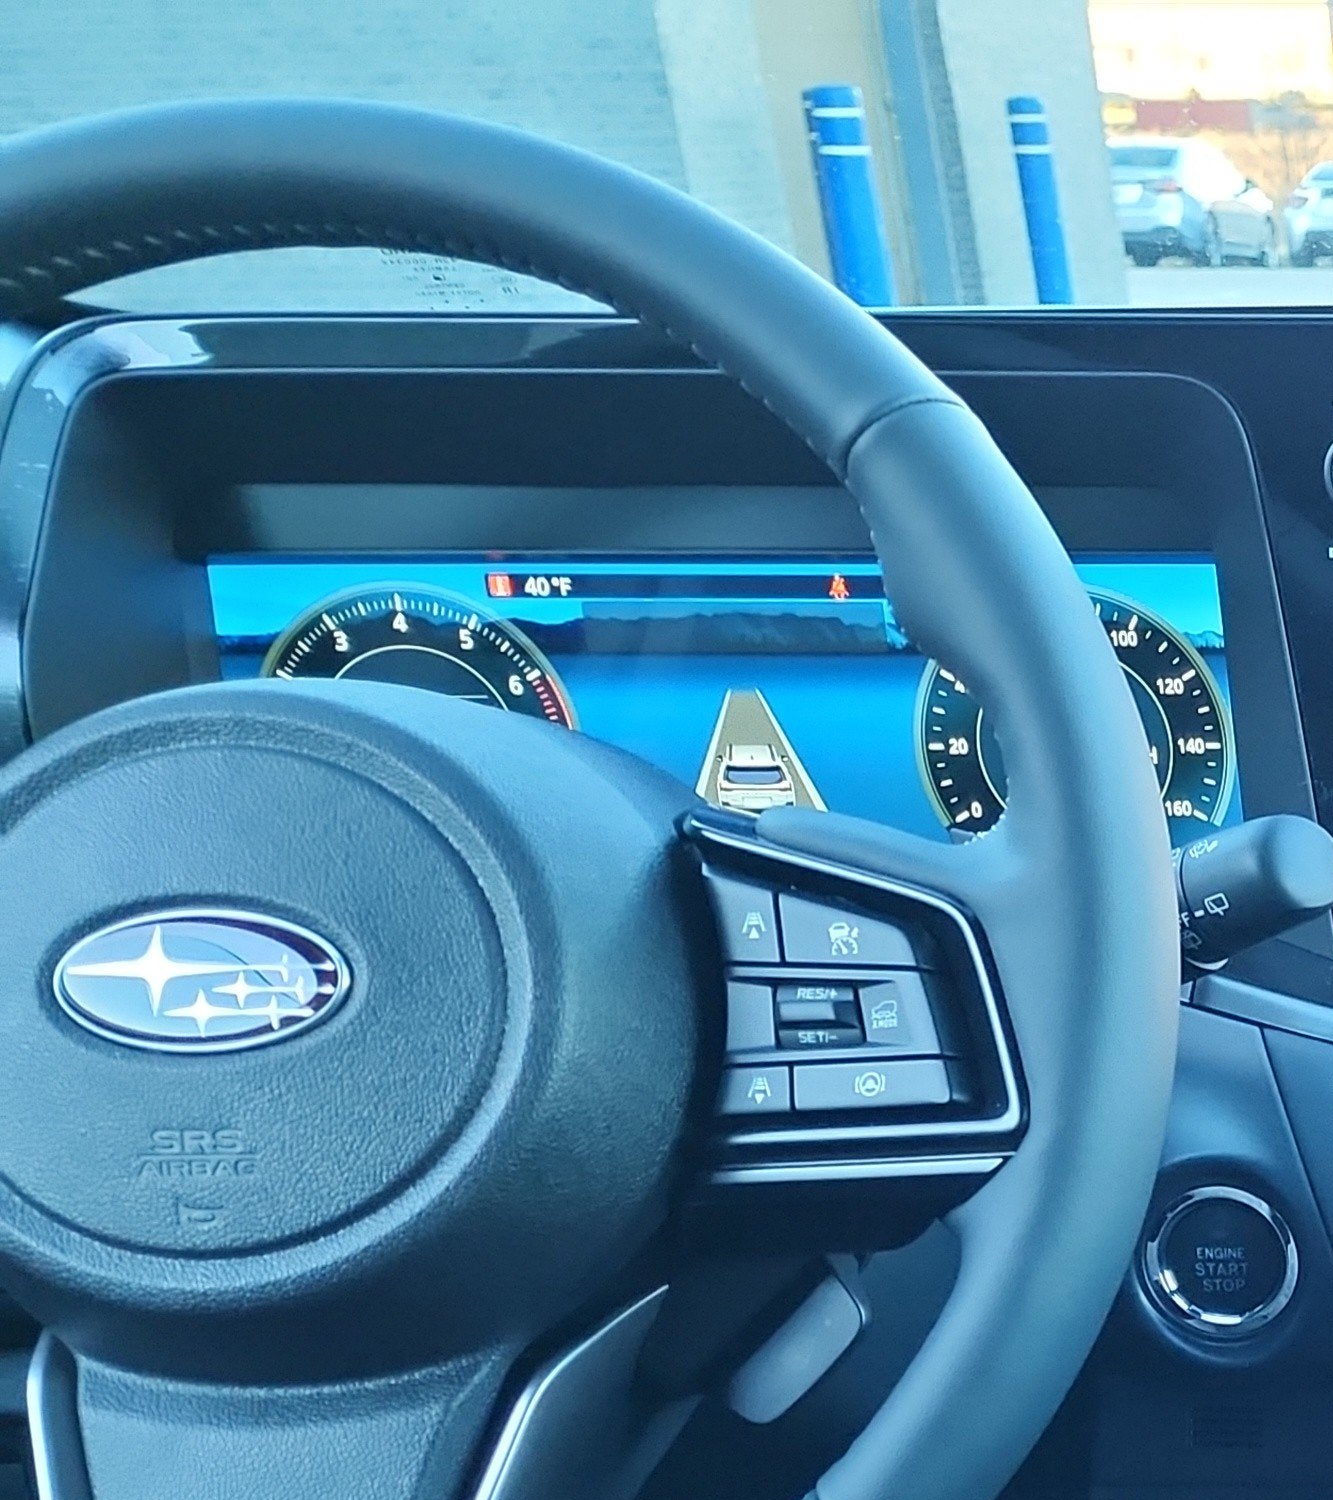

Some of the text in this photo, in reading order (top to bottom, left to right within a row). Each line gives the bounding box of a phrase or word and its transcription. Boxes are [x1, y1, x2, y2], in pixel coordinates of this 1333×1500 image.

[392, 613, 409, 633] 4
[334, 631, 349, 652] 3
[458, 629, 474, 650] 5
[1110, 630, 1138, 647] 100
[508, 674, 524, 695] 6
[1156, 678, 1184, 695] 120
[949, 739, 968, 755] 20
[1178, 738, 1205, 755] 140
[972, 803, 983, 819] 0
[1165, 800, 1192, 817] 160
[151, 1130, 243, 1153] SRS
[138, 1159, 259, 1176] AIRBAG
[1196, 1247, 1245, 1259] ENGINE
[1195, 1263, 1249, 1276] START
[1203, 1278, 1246, 1292] STOP
